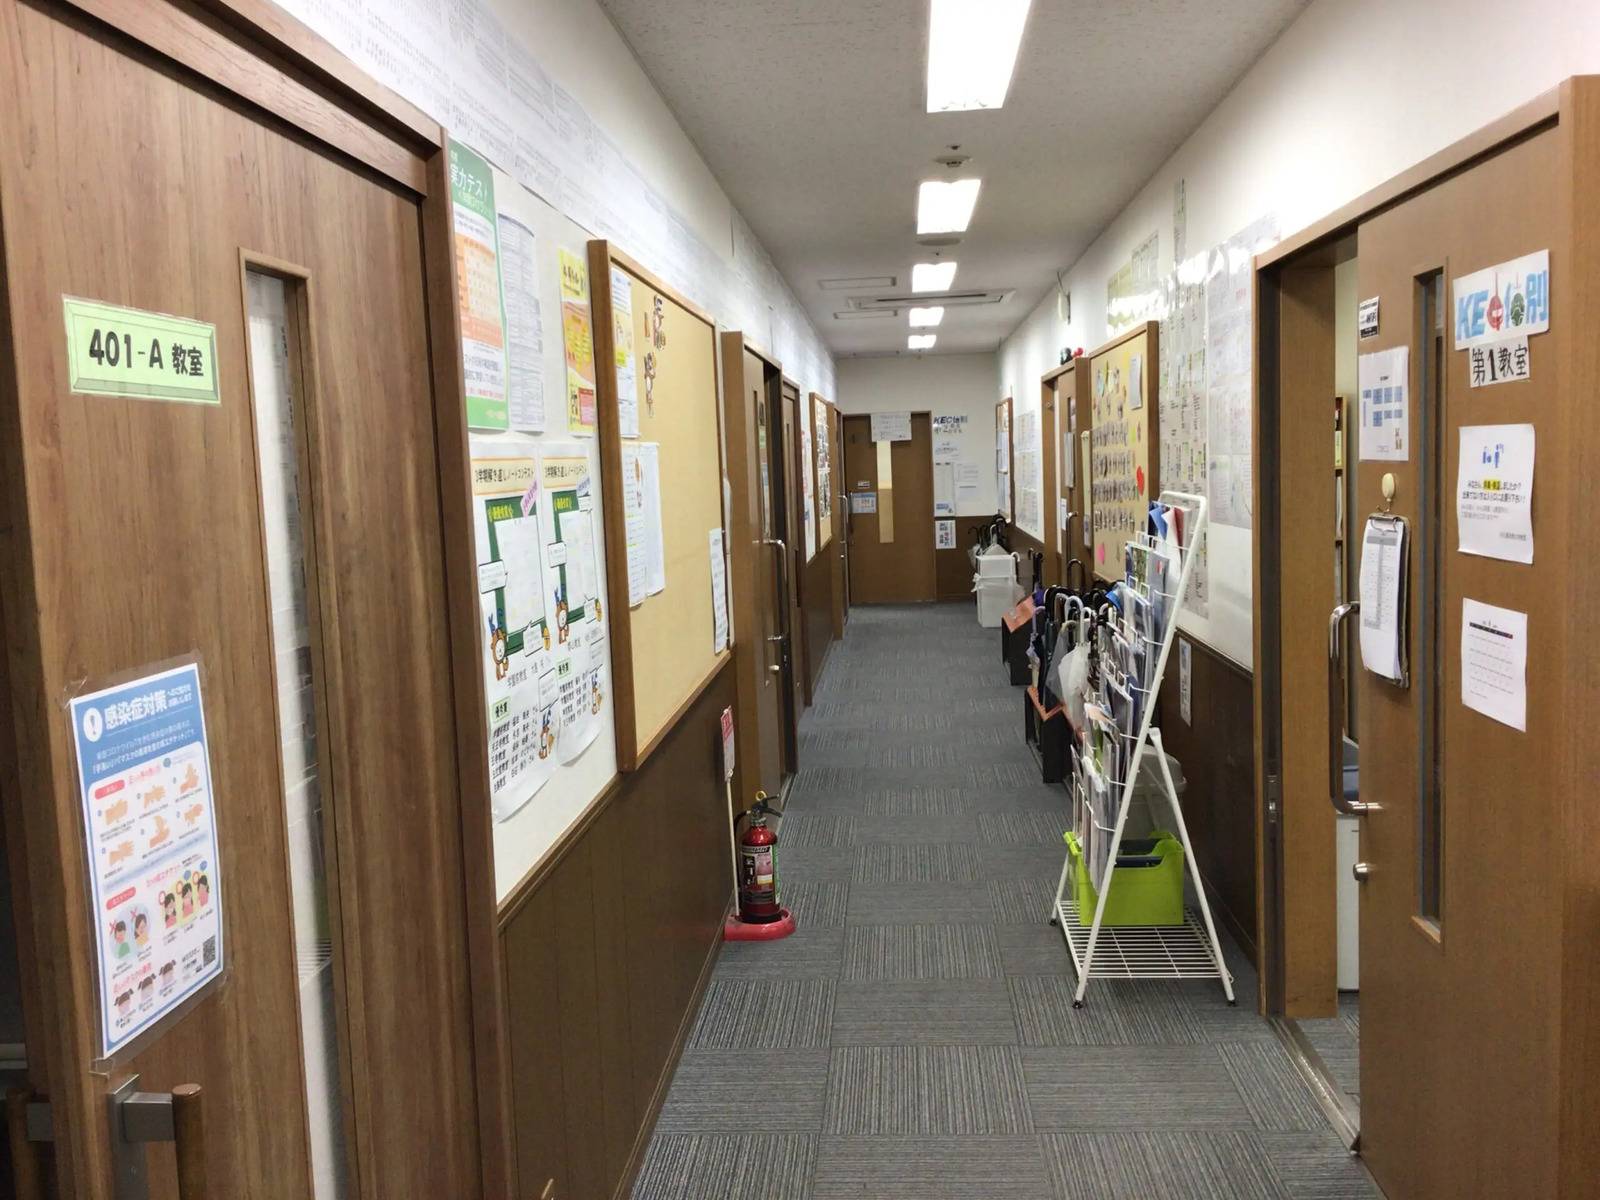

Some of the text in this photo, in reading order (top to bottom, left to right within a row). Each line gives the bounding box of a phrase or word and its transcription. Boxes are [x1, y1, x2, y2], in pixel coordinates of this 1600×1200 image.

[89, 328, 204, 377] 401-A 教室
[1472, 344, 1528, 383] 第1教室
[104, 689, 168, 730] 感染症対策
